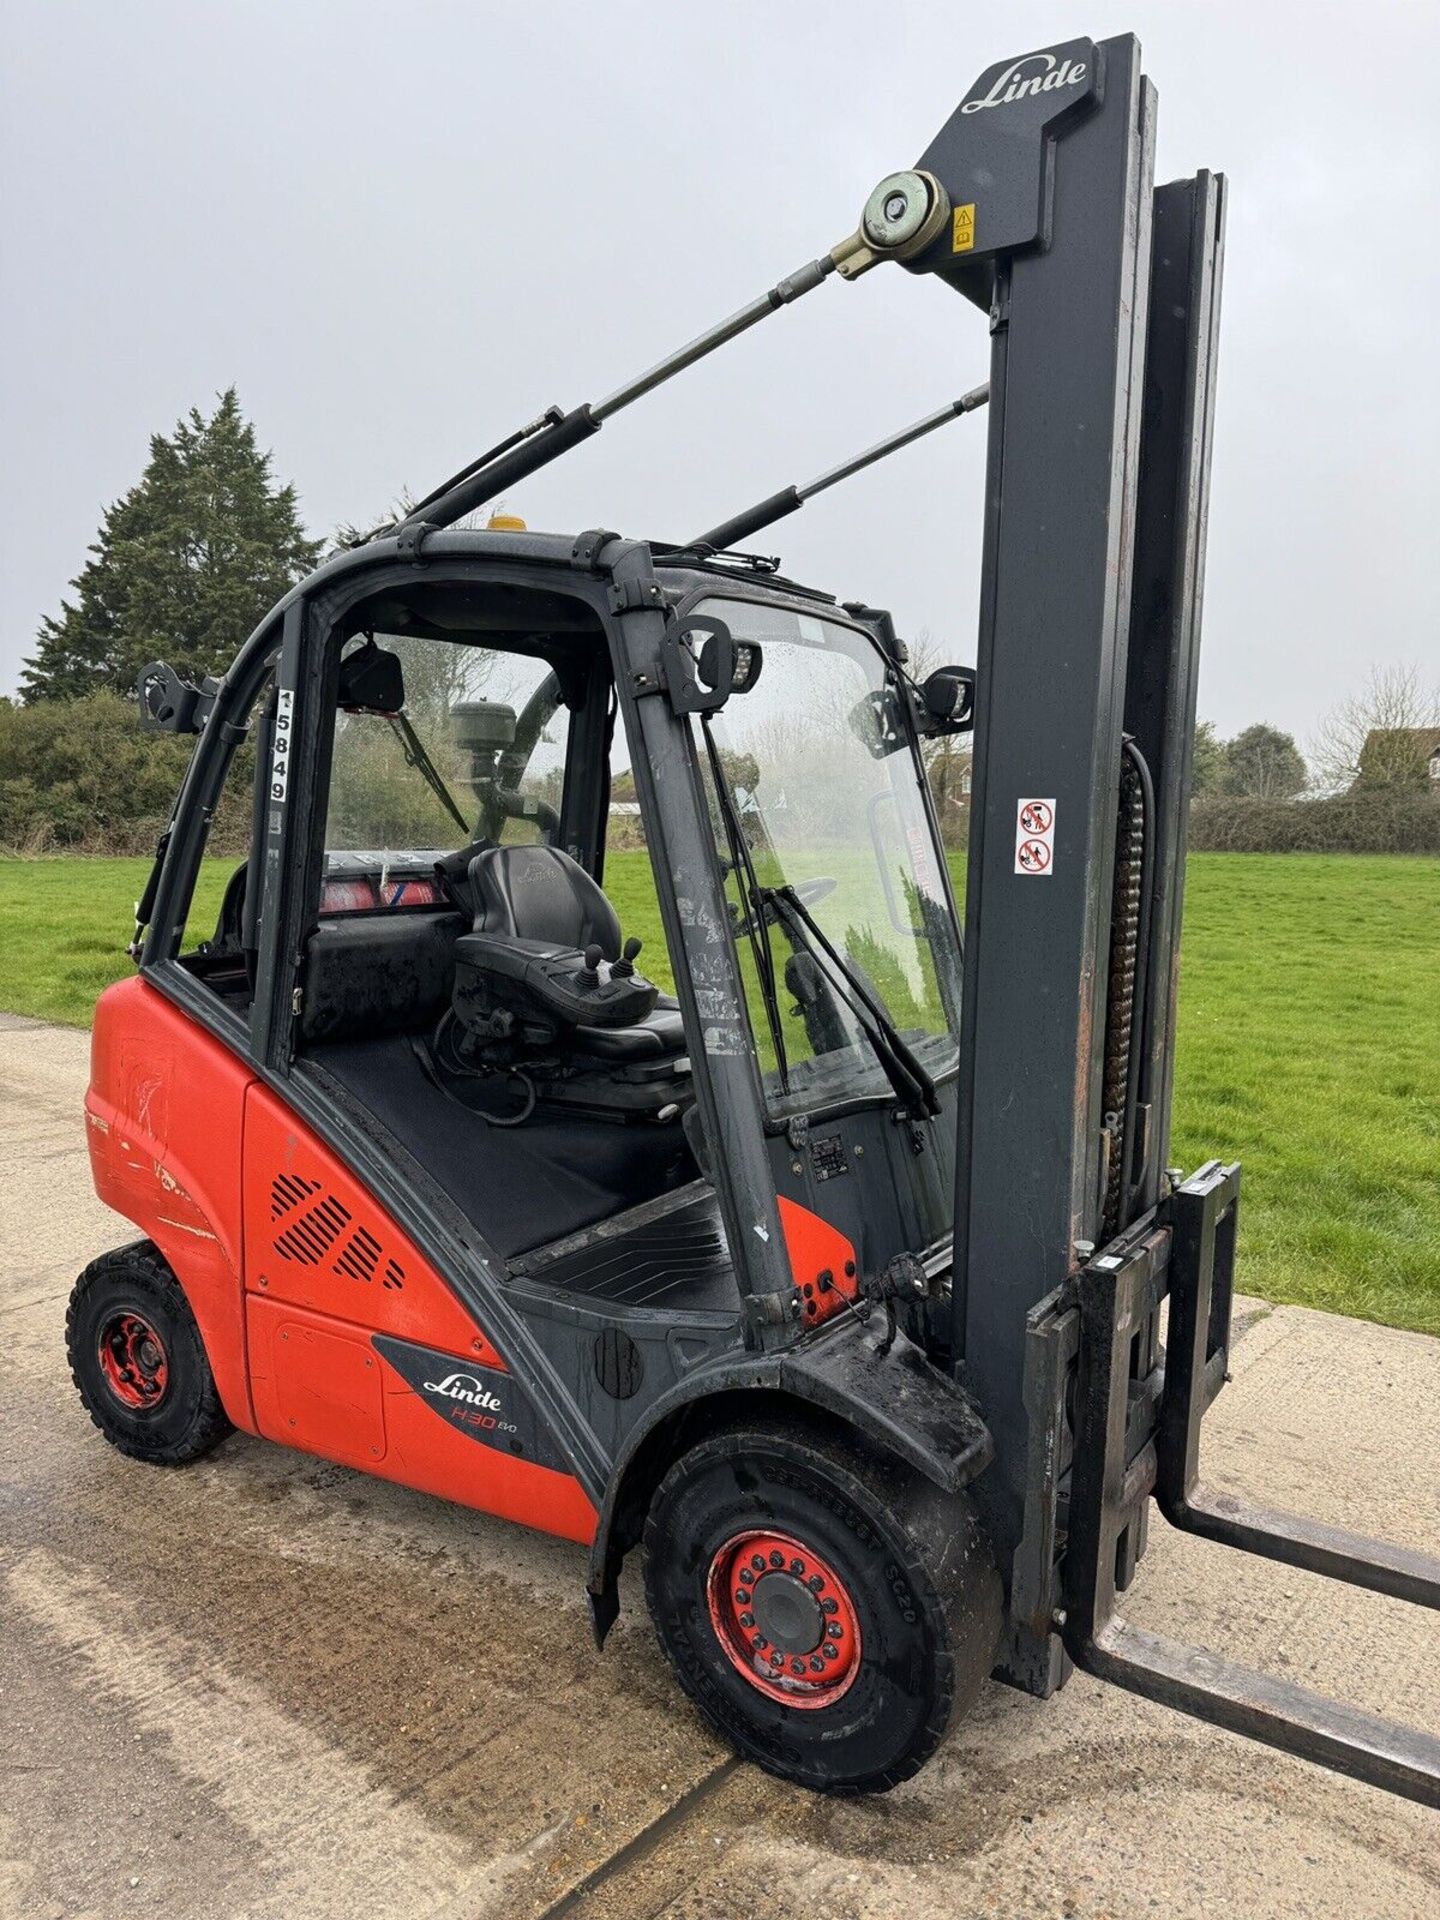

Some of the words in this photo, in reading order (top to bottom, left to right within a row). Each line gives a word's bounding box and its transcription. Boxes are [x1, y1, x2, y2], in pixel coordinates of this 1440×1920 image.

[961, 54, 1086, 114] Linde
[423, 1373, 501, 1411] Linde
[452, 1407, 497, 1429] H30
[497, 1421, 518, 1434] EVO
